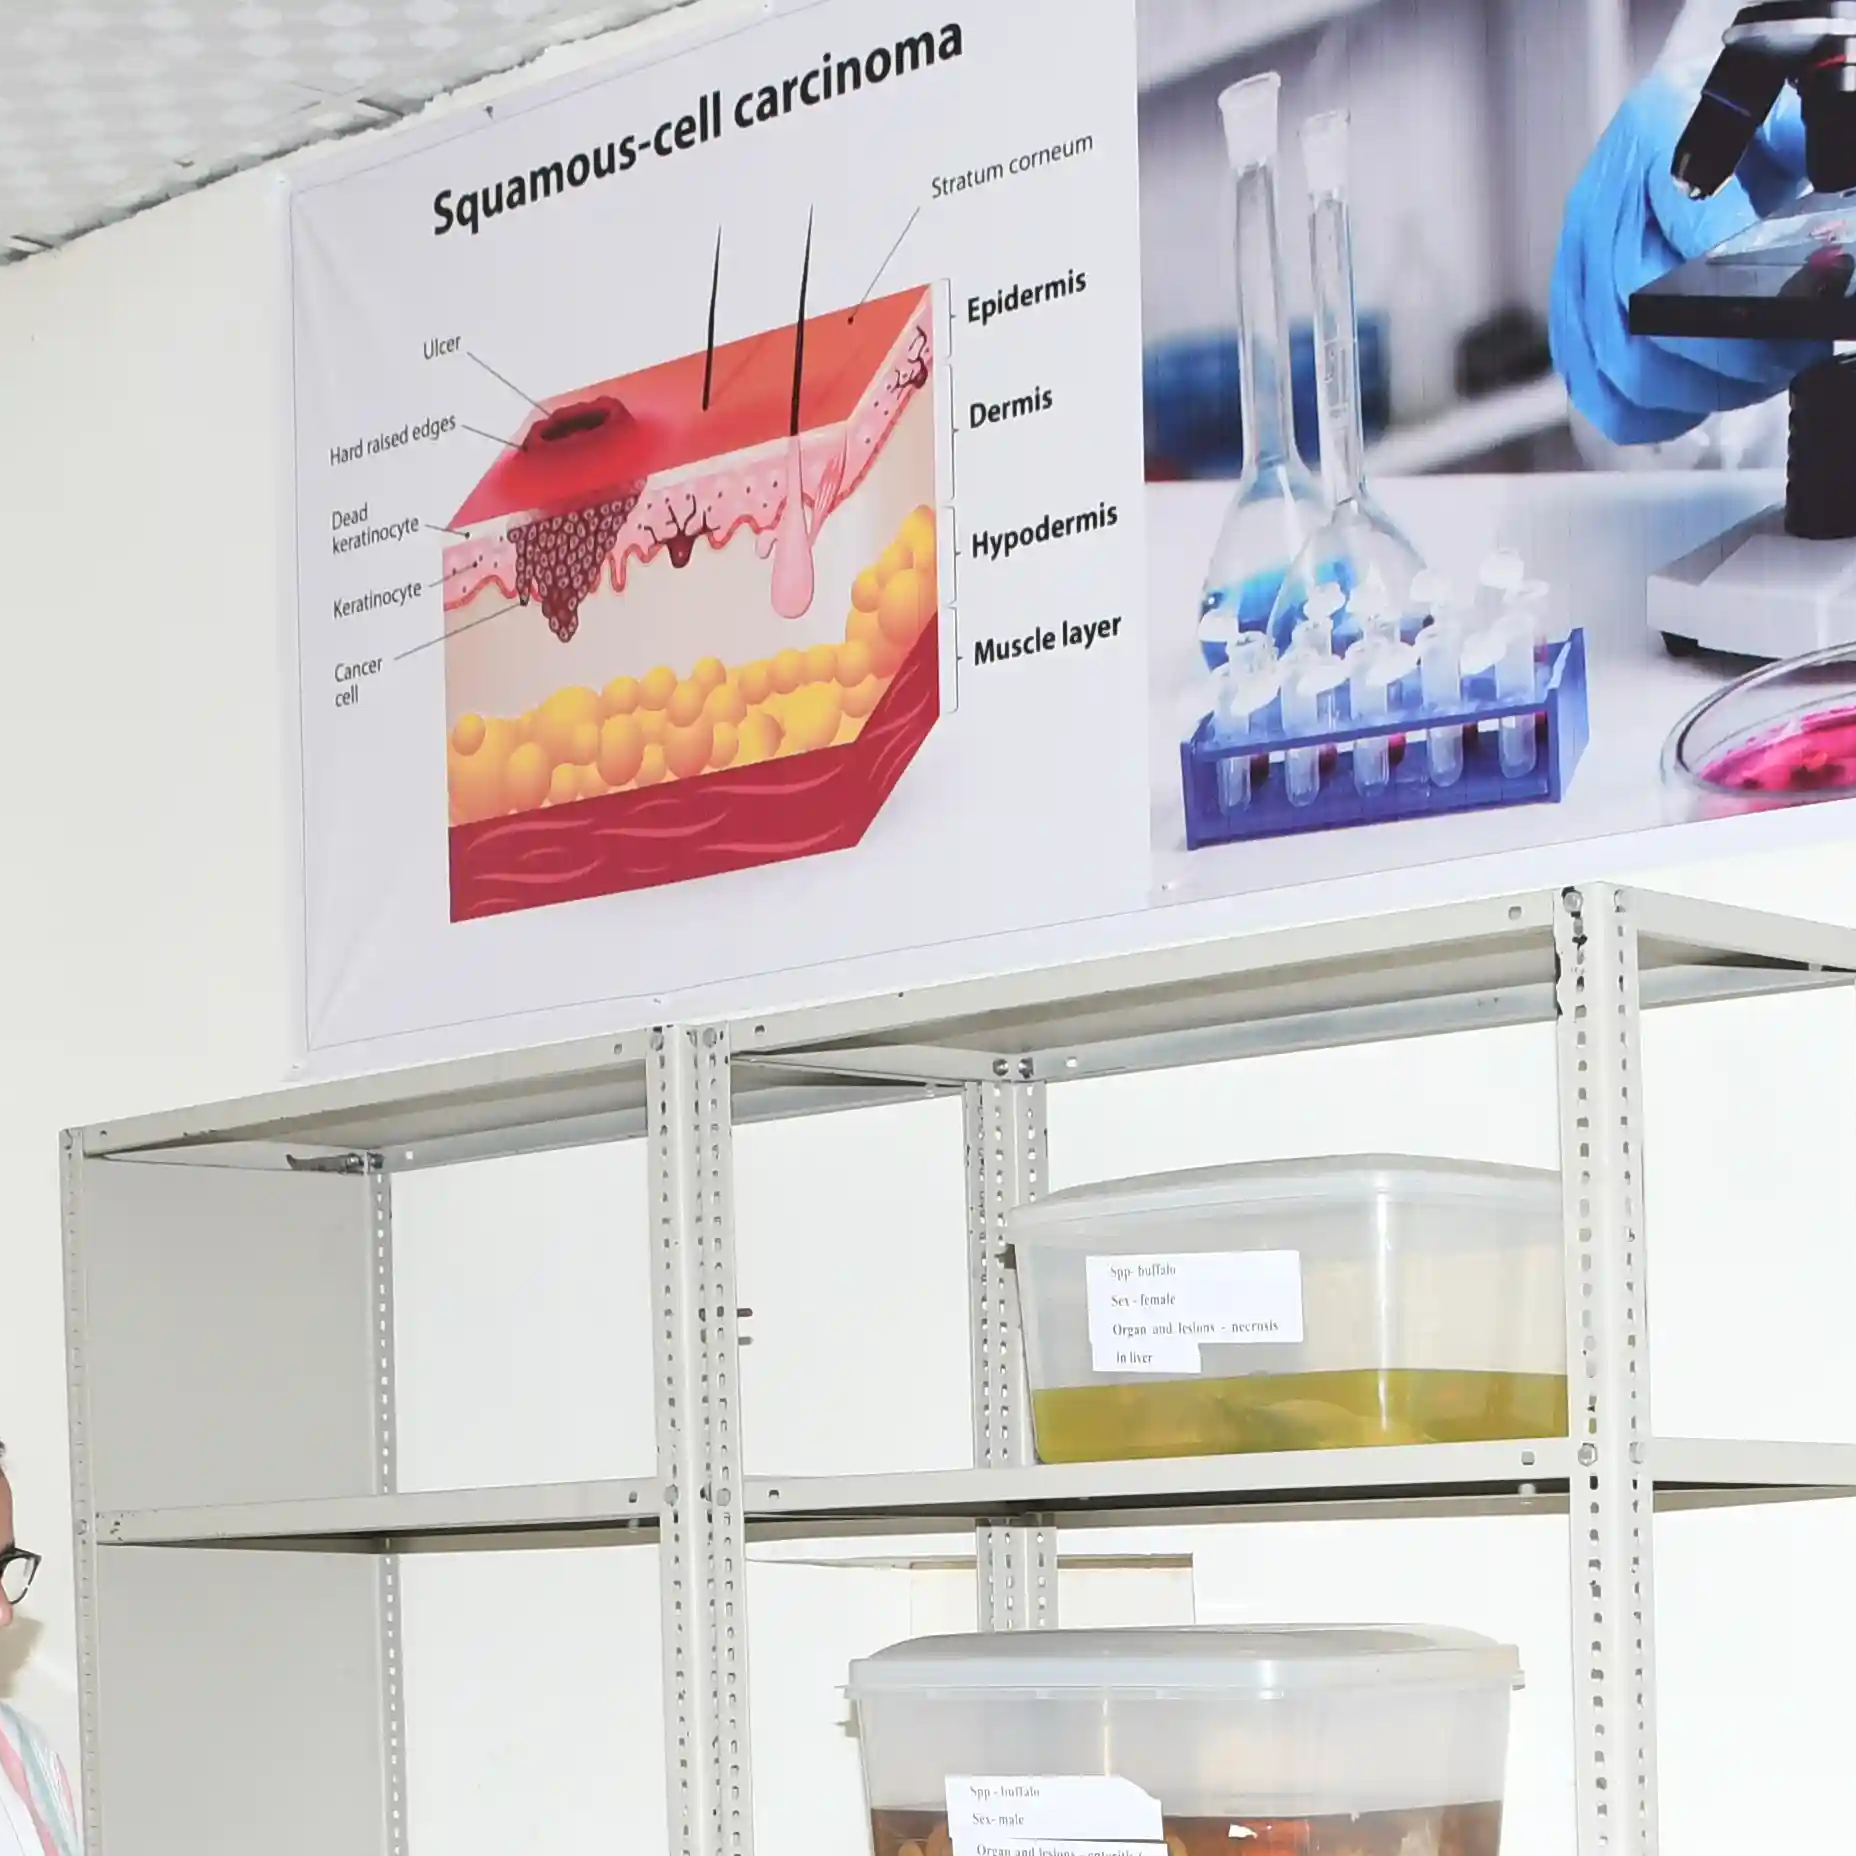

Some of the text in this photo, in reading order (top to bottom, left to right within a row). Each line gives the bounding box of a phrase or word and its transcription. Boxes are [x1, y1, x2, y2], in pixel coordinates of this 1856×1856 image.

[432, 21, 964, 238] Squamous-cell carcinoma
[931, 132, 1095, 201] Stratum corneum
[967, 270, 1088, 326] Epidermis
[422, 333, 462, 361] Ulcer
[969, 386, 1053, 429] Dermis
[330, 412, 457, 468] Hard raised edges
[331, 502, 368, 532] Dead
[971, 501, 1118, 562] Hypodermis
[331, 514, 420, 556] keratinocyte
[332, 579, 422, 620] Keratinocyte
[973, 613, 1123, 667] Muscle layer
[334, 654, 383, 683] Cancer
[334, 683, 359, 708] cell
[1138, 1263, 1176, 1276] buffalo
[1111, 1295, 1130, 1307] Sex
[1140, 1293, 1176, 1306] female
[1113, 1324, 1146, 1338] Organ
[1152, 1323, 1172, 1334] and
[1178, 1322, 1215, 1334] lesions
[1232, 1320, 1278, 1332] necrosis
[1130, 1351, 1152, 1364] liver
[970, 1786, 990, 1799] Spp
[1001, 1786, 1040, 1797] buffalo
[999, 1814, 1024, 1825] male
